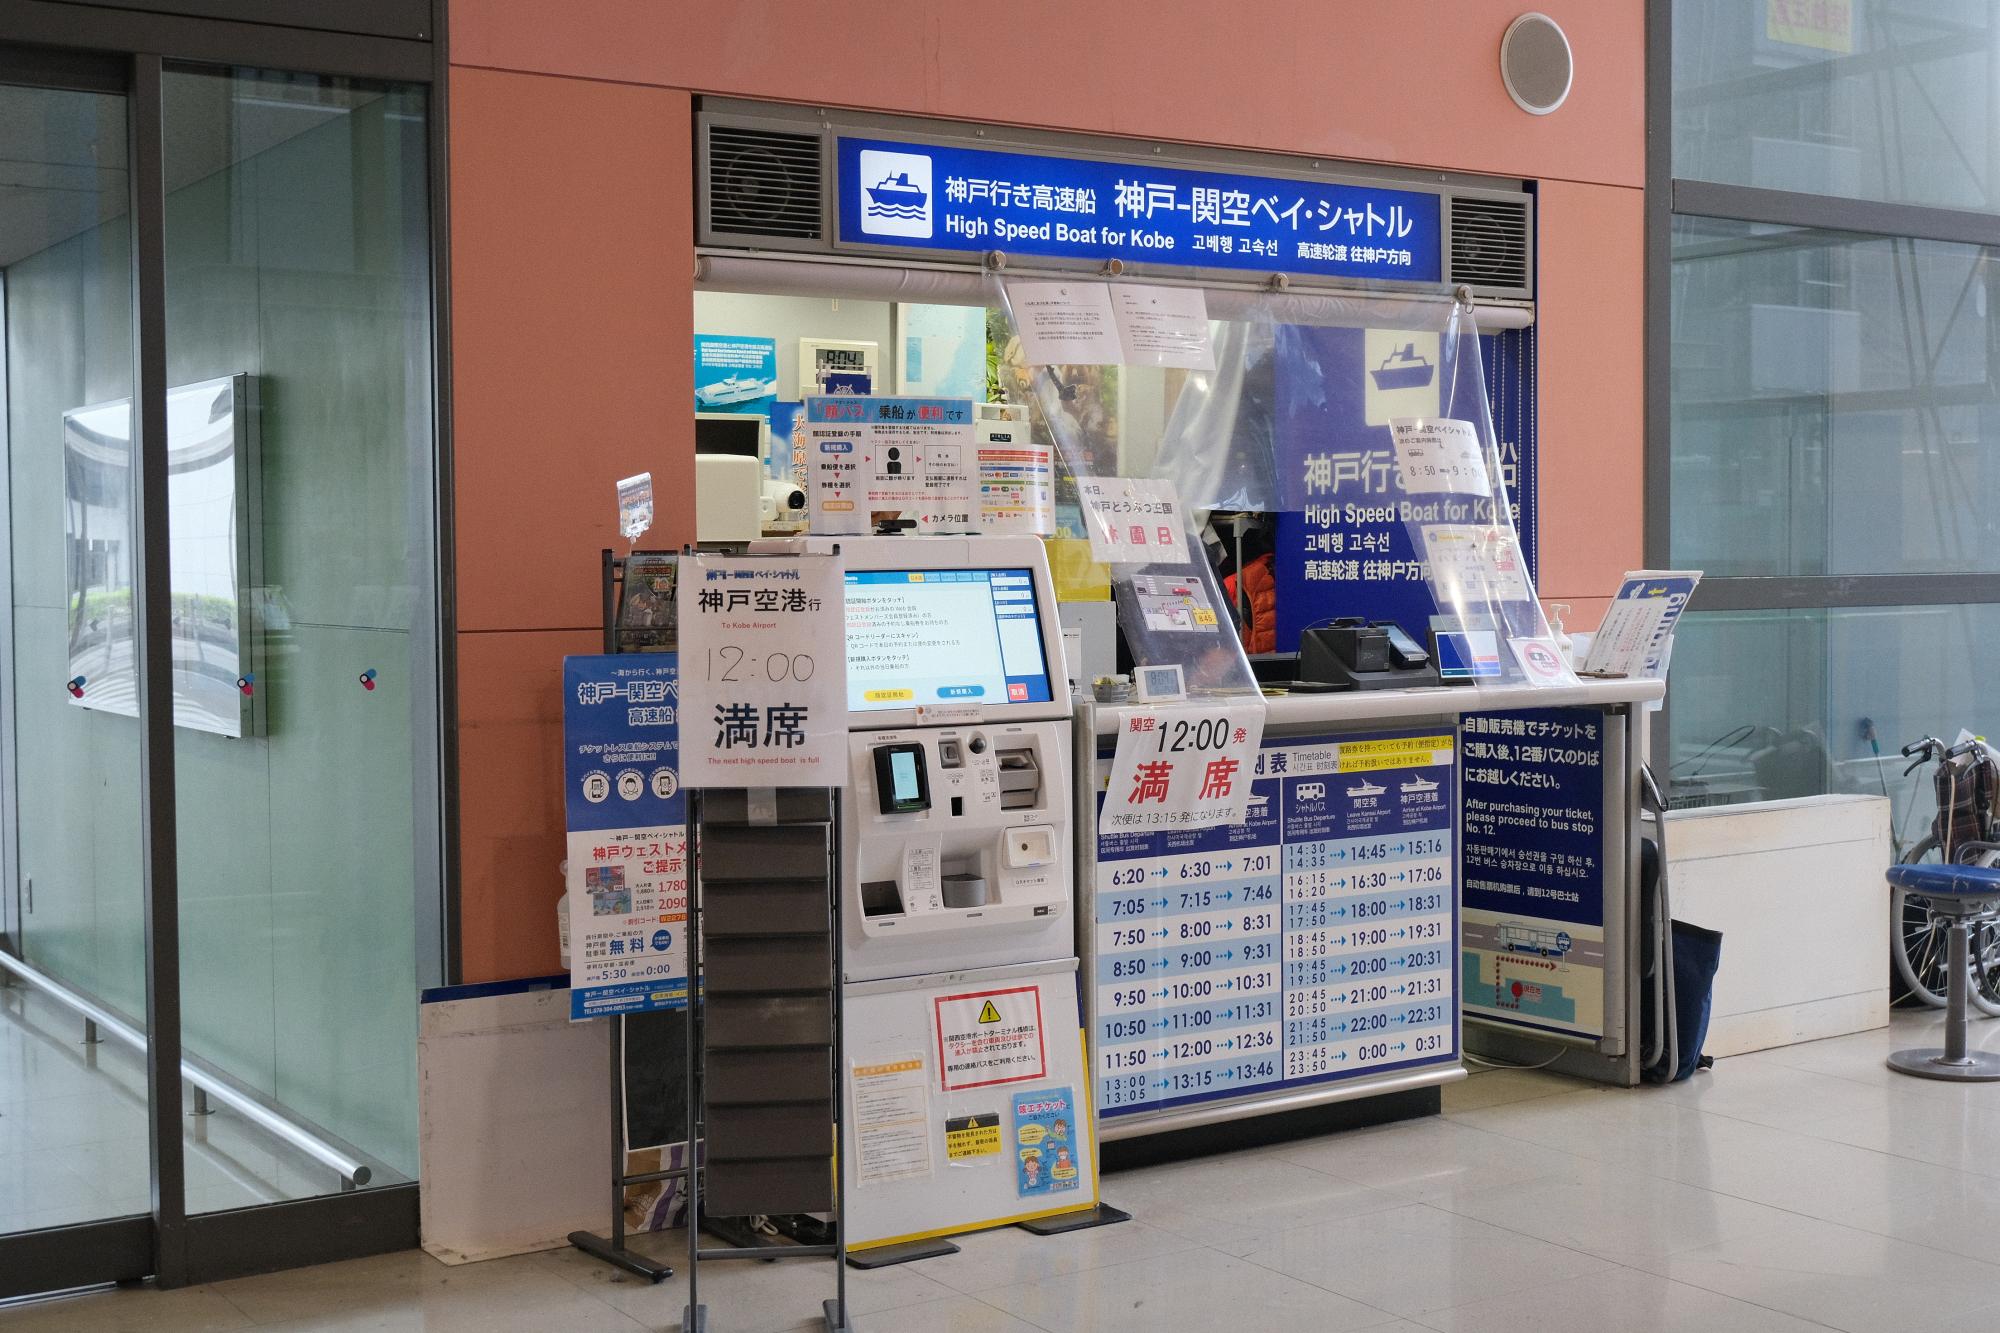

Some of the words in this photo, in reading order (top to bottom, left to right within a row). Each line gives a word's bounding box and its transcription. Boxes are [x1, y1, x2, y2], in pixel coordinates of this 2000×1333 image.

[945, 176, 1096, 214] 神戸行き高速船
[946, 214, 988, 239] High
[994, 218, 1050, 240] Speed
[1056, 224, 1096, 243] Boat
[1102, 227, 1126, 246] for
[1131, 229, 1174, 249] Kobe
[1192, 234, 1233, 254] 고베행
[1238, 237, 1277, 257] 고속선
[1298, 242, 1347, 262] 高速轮渡
[1351, 246, 1411, 265] 往神户方向
[932, 515, 968, 523] カメラ位置
[1304, 504, 1340, 528] High
[1345, 503, 1395, 527] Speed
[1401, 502, 1438, 521] Boat
[1444, 501, 1468, 521] for
[1474, 500, 1519, 520] Kobe
[1305, 533, 1343, 553] 고베행
[1350, 532, 1389, 552] 고속선
[1305, 560, 1359, 580] 高速轮渡
[1364, 560, 1433, 581] 往神户方向
[699, 588, 821, 613] 神戸空港行
[707, 646, 814, 682] 12:00
[714, 702, 808, 749] 満席
[1130, 716, 1155, 732] 関空
[1158, 718, 1229, 752] 12:00
[1233, 728, 1247, 744] 発
[1465, 717, 1596, 740] 自動販売機でチケットを
[740, 757, 755, 765] high
[758, 757, 778, 766] speed
[1292, 751, 1331, 761] Timetable
[1465, 743, 1600, 766] ご購入後、12番バスのりば
[1292, 762, 1313, 771] 시간표
[1128, 756, 1240, 804] 満席
[1465, 767, 1561, 790] にお越しください。
[1296, 802, 1325, 813] シャトルバス
[1353, 797, 1378, 809] 関空発
[1401, 792, 1438, 804] 神戸空港着
[1112, 813, 1142, 825] 次便は
[1146, 811, 1177, 824] 13:15
[1180, 807, 1237, 822] 発になります。
[1466, 798, 1487, 810] After
[1490, 800, 1540, 817] purchasing
[1542, 807, 1563, 821] your
[1566, 809, 1594, 822] ticket,
[1466, 812, 1495, 823] please
[1499, 814, 1536, 827] proceed
[1539, 818, 1548, 828] to
[1552, 820, 1568, 831] bus
[1572, 823, 1593, 835] stop
[1466, 823, 1481, 834] No.
[1483, 825, 1495, 835] 12.
[1289, 843, 1325, 856] 14:30
[1351, 844, 1386, 860] 14:45
[1408, 839, 1441, 855] 15:16
[1466, 844, 1515, 859] 자동판매기에서
[1550, 853, 1565, 864] 구입
[1567, 856, 1582, 866] 하신
[1113, 868, 1144, 885] 6:20
[1180, 862, 1211, 879] 6:30
[1243, 856, 1271, 872] 7:01
[1351, 873, 1386, 889] 16:30
[1408, 867, 1442, 883] 17:06
[1466, 855, 1481, 866] 12번
[1484, 857, 1498, 867] 버스
[1539, 865, 1553, 874] 이동
[1556, 866, 1588, 878] 하십시오.
[1113, 899, 1145, 916] 7:05
[1180, 891, 1211, 908] 7:15
[1243, 885, 1272, 901] 7:46
[1289, 902, 1326, 915] 17:45
[1351, 901, 1386, 918] 18:00
[1408, 895, 1440, 911] 18:31
[1113, 929, 1145, 946] 7:50
[1180, 921, 1211, 938] 8:00
[1243, 914, 1271, 931] 8:31
[1351, 929, 1386, 946] 19:00
[1408, 923, 1440, 939] 19:31
[610, 937, 644, 955] 無料
[602, 968, 627, 980] 5:30
[646, 964, 670, 976] 0:00
[1113, 959, 1145, 977] 8:50
[1180, 951, 1211, 968] 9:00
[1243, 944, 1271, 960] 9:31
[1289, 960, 1326, 973] 19:45
[1351, 958, 1387, 975] 20:00
[1408, 951, 1440, 968] 20:31
[1113, 989, 1146, 1007] 9:50
[1172, 981, 1211, 998] 10:00
[1235, 973, 1272, 990] 10:31
[1351, 986, 1387, 1003] 21:00
[1408, 978, 1441, 995] 21:31
[1105, 1020, 1146, 1038] 10:50
[1173, 1010, 1211, 1028] 11:00
[1236, 1002, 1272, 1020] 11:31
[1289, 1018, 1326, 1032] 21:45
[1351, 1014, 1387, 1032] 22:00
[1408, 1006, 1441, 1024] 22:31
[1106, 1050, 1146, 1068] 11:50
[1173, 1040, 1212, 1058] 12:00
[1236, 1031, 1273, 1049] 12:36
[1359, 1044, 1387, 1060] 0:00
[1416, 1035, 1441, 1051] 0:31
[1106, 1076, 1145, 1090] 13:00
[1173, 1071, 1212, 1089] 13:15
[1236, 1061, 1273, 1079] 13:46
[1106, 1089, 1145, 1104] 13:05
